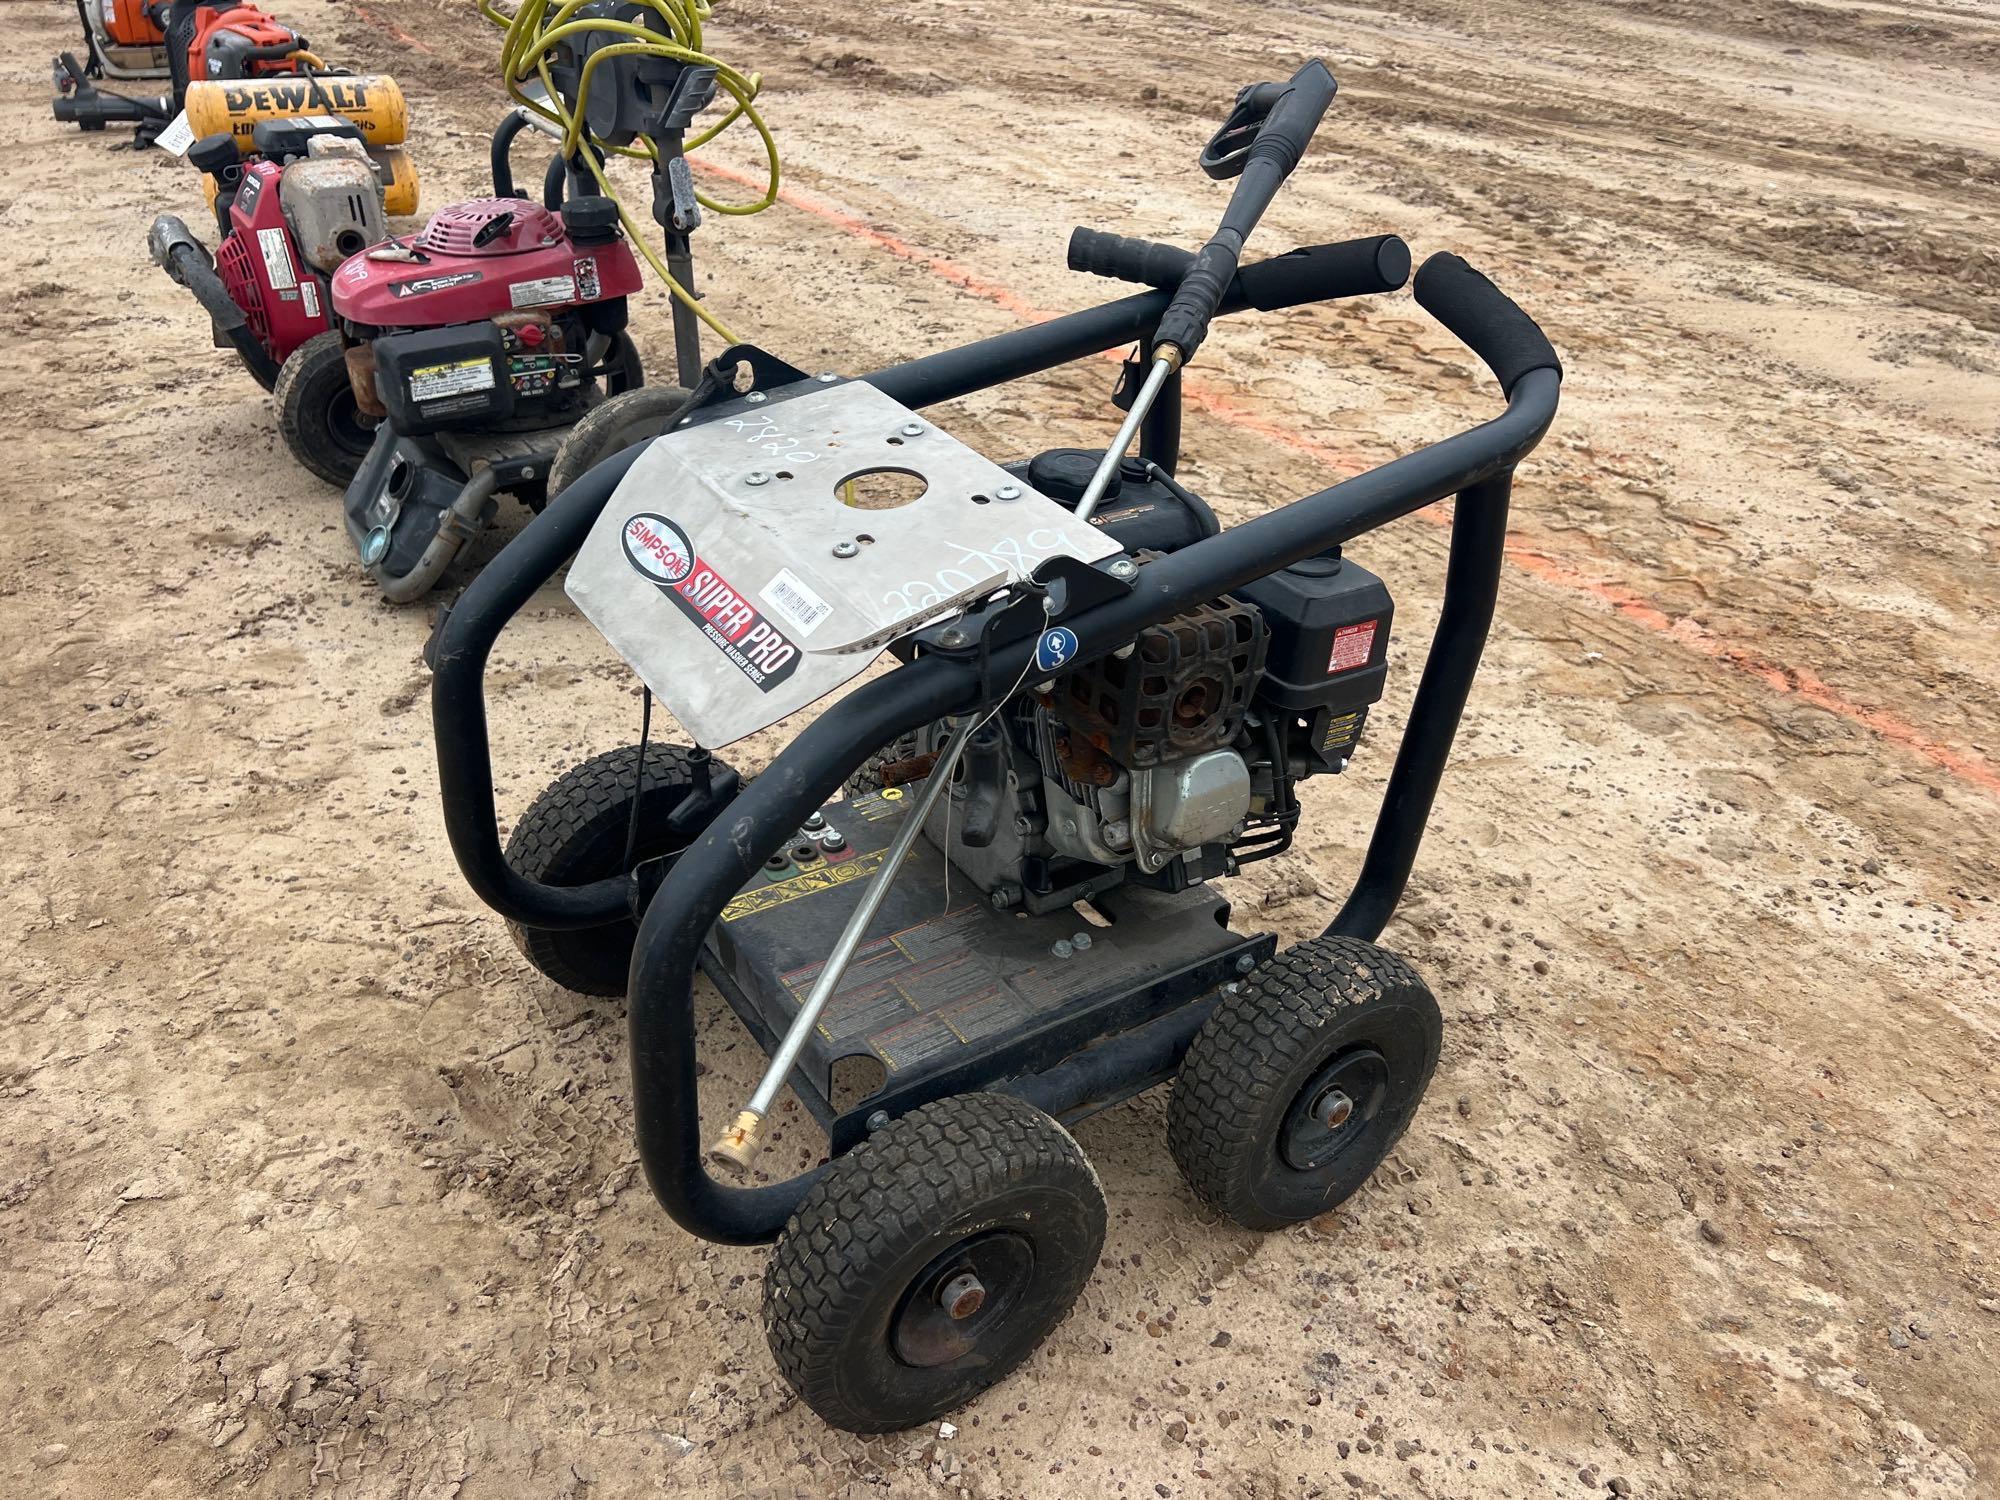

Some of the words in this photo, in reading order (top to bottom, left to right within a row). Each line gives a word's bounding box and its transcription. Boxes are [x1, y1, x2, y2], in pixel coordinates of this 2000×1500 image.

[723, 415, 821, 463] 2820
[629, 521, 689, 578] SIMPSON
[681, 570, 754, 637] SUPER
[736, 622, 795, 675] PRO
[702, 622, 730, 650] PRESSURE
[724, 643, 747, 669] WASHER
[743, 663, 766, 684] SERIES
